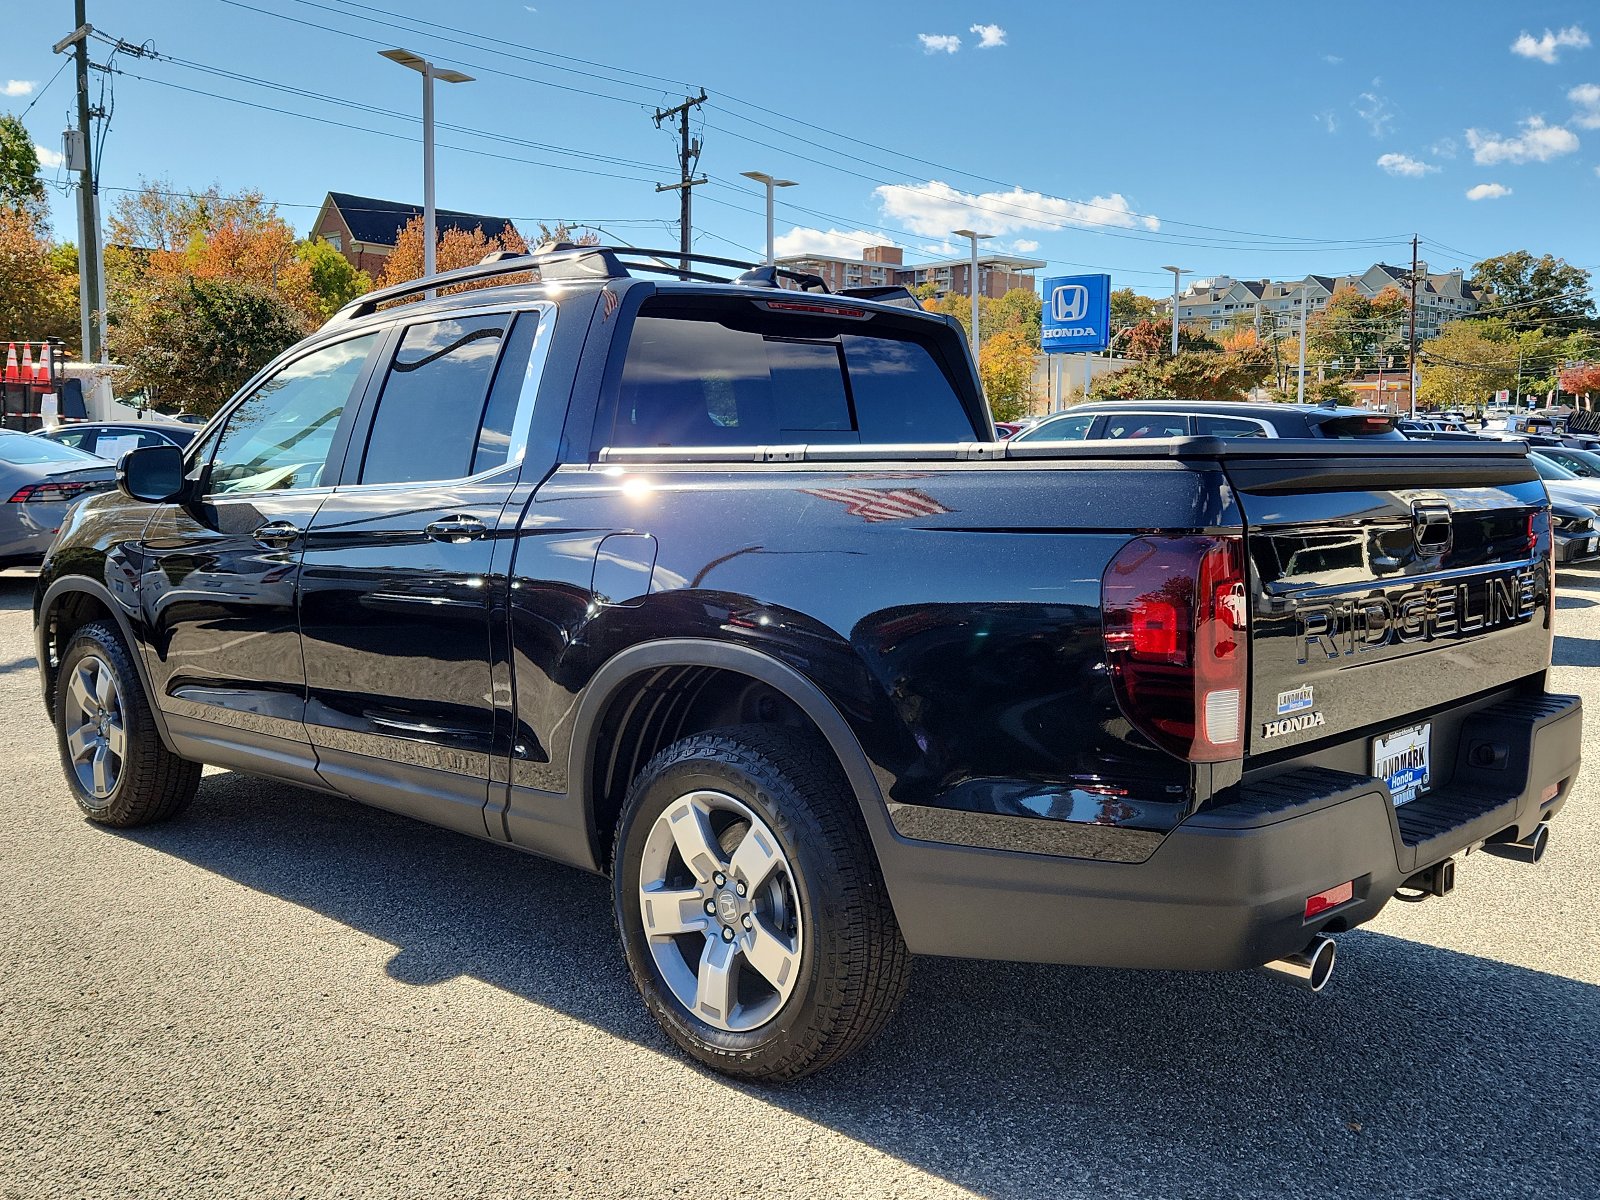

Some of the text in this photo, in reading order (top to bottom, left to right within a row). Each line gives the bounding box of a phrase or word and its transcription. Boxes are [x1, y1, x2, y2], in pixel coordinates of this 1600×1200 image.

[1043, 327, 1097, 339] HONDA
[1295, 570, 1537, 665] RIDGELINE
[1262, 711, 1326, 739] HONDA
[1377, 746, 1426, 780] LANDMARK
[1391, 770, 1413, 788] Honda
